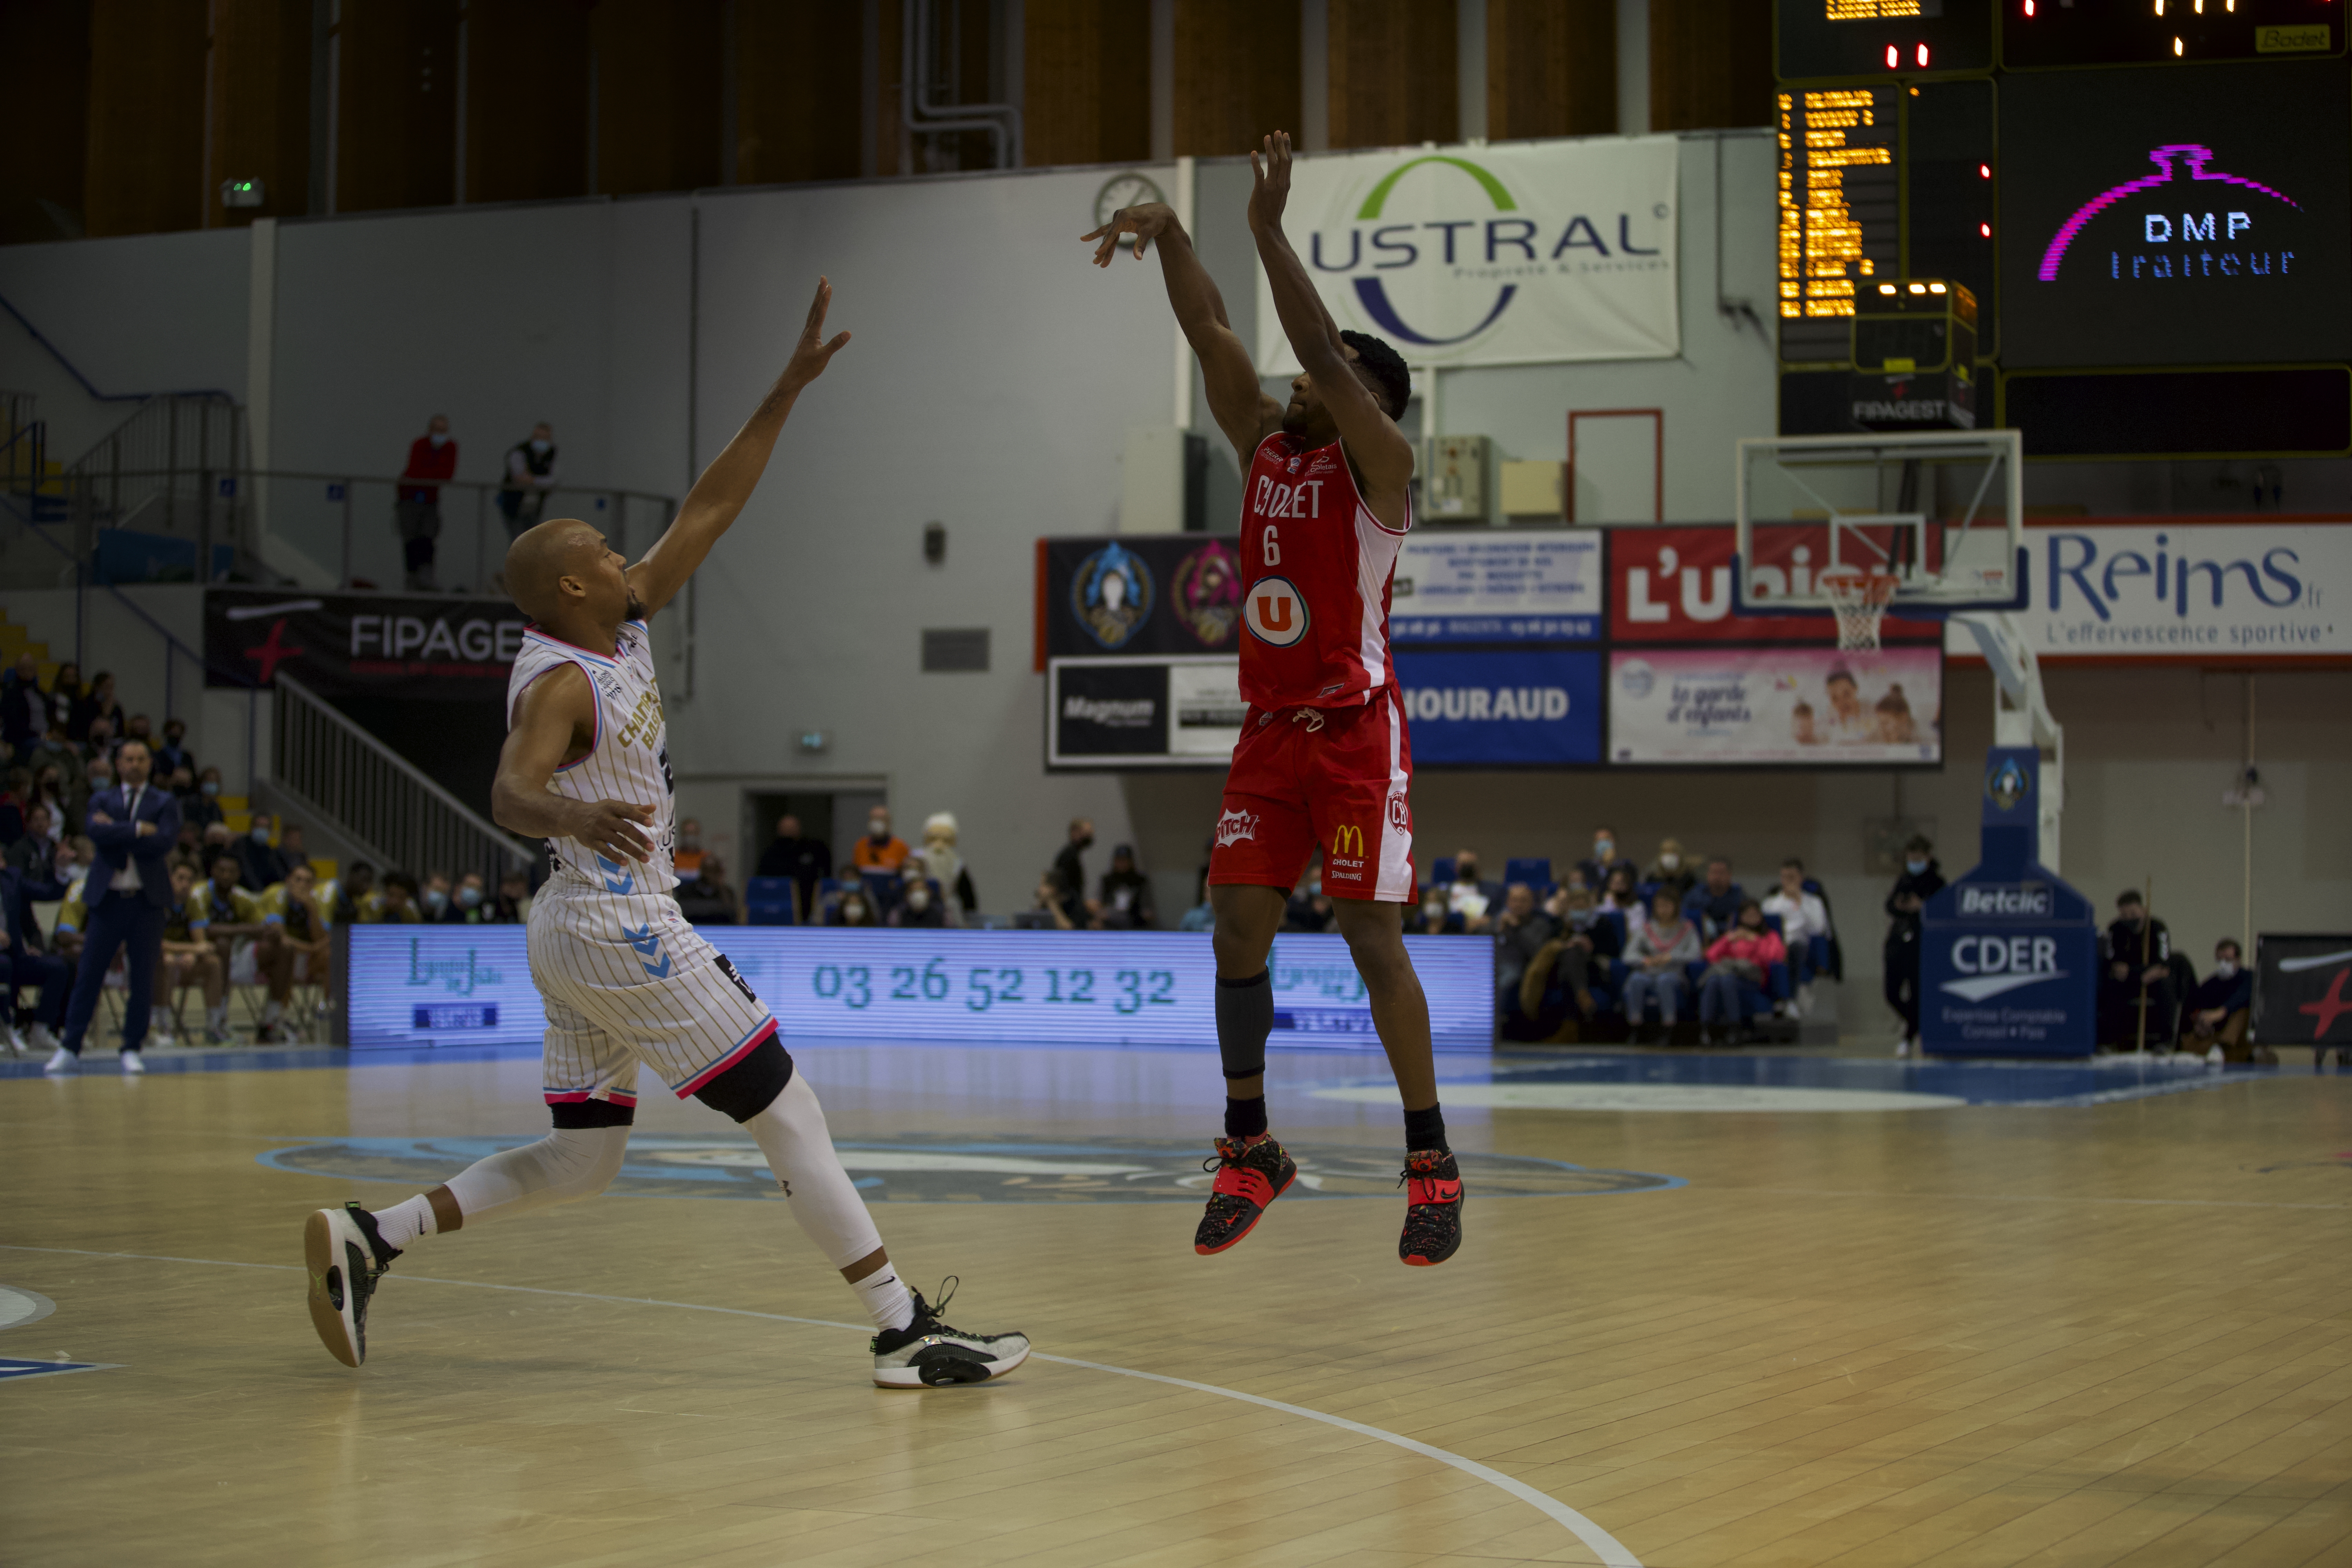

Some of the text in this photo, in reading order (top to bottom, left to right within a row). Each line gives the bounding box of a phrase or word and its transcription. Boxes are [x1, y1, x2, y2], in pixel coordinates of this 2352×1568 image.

[2261, 30, 2326, 48] Bodet
[2145, 212, 2252, 243] DMP
[1311, 214, 1661, 272] USTRAL
[1852, 399, 1947, 420] FIPAGEST
[1259, 449, 1280, 465] Transports
[1263, 526, 1281, 566] 6
[1257, 596, 1292, 632] U
[2047, 621, 2321, 647] L'effervescence sportive
[1392, 800, 1406, 825] CB
[1331, 870, 1362, 882] SPALDING
[1333, 858, 1364, 868] CHOLET
[1961, 886, 2048, 914] Betclic
[1950, 935, 2058, 974] CDER
[812, 957, 1175, 1014] 03 26 52 12 32
